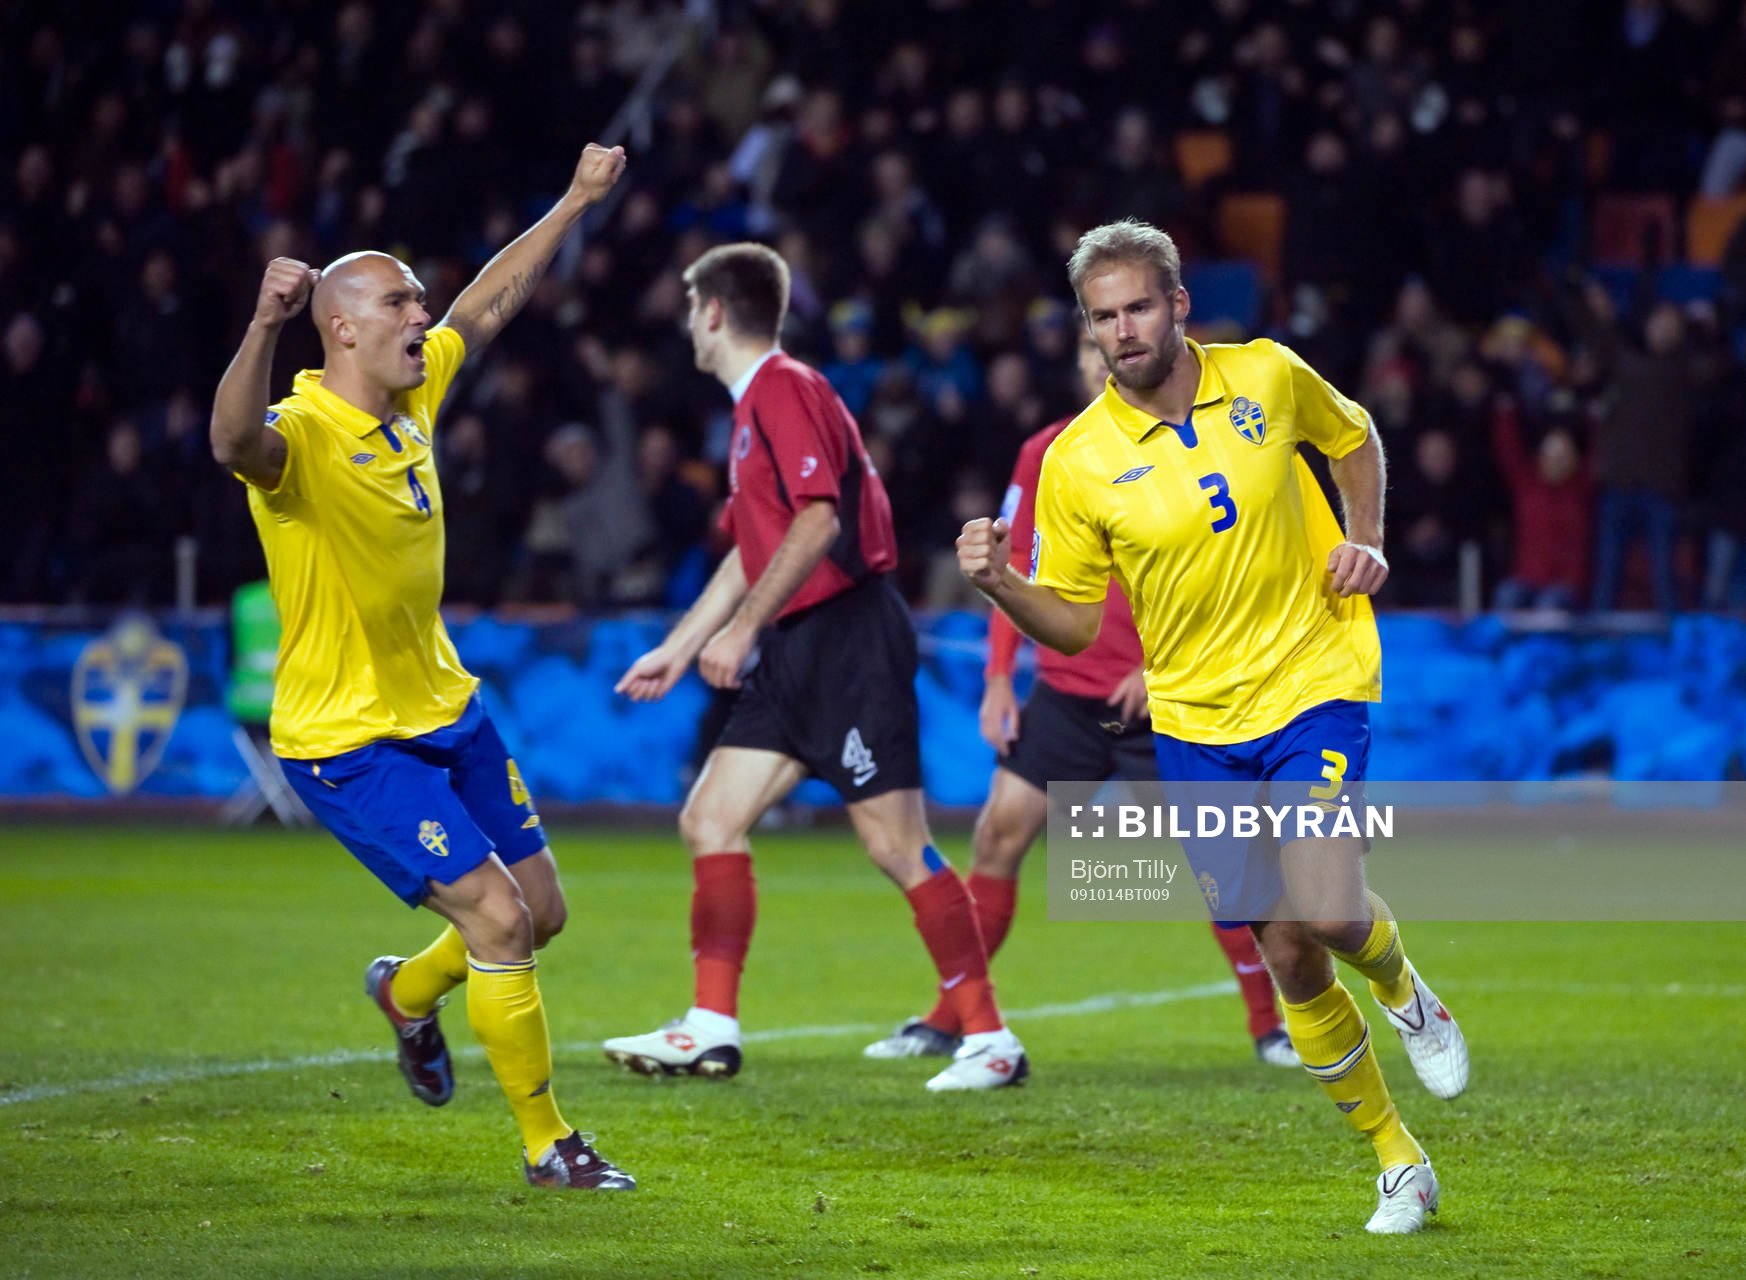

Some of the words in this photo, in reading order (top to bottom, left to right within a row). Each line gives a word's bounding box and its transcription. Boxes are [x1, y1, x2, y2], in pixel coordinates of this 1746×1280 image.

[406, 465, 432, 518] 4
[1198, 472, 1238, 534] 3
[841, 727, 876, 775] 4
[1309, 748, 1348, 800] 3
